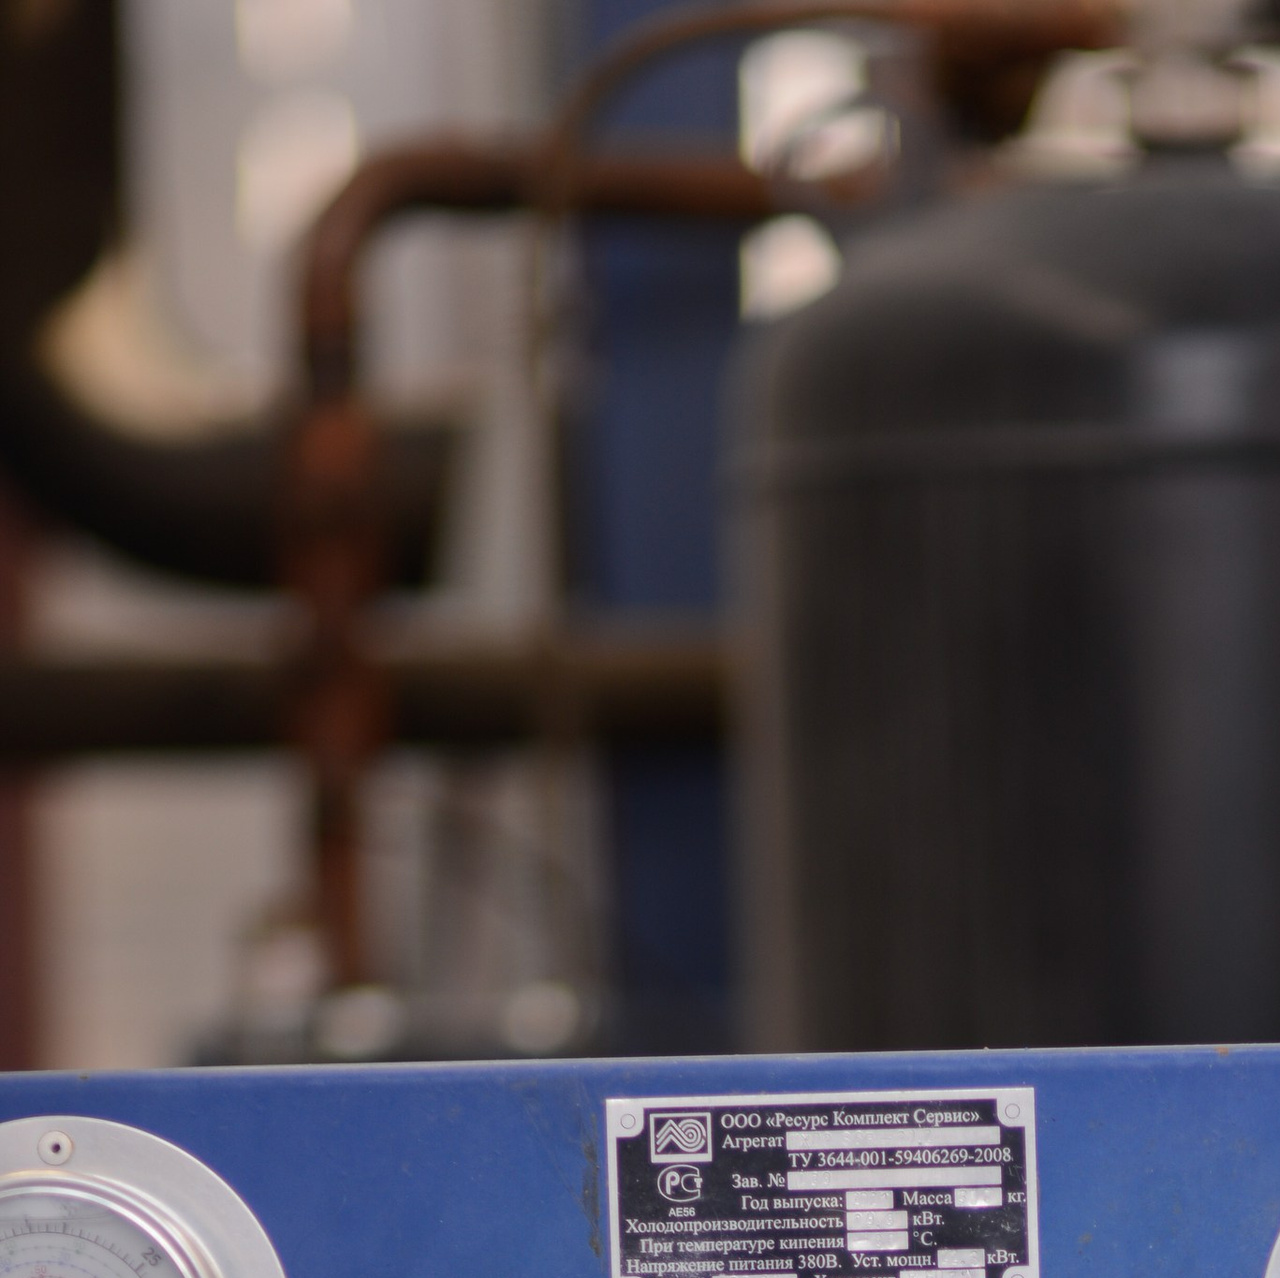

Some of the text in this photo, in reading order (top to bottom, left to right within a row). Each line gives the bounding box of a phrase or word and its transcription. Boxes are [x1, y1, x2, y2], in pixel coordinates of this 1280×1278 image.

[721, 1108, 981, 1130] ООО «Ресурс Комплект Сервис»
[721, 1133, 785, 1152] Агрегат
[788, 1147, 1012, 1168] ТУ 3644-001-59406269-2008
[731, 1173, 763, 1189] Зав.
[767, 1172, 786, 1188] №
[741, 1195, 769, 1211] Год
[773, 1193, 844, 1211] выпуска:
[902, 1191, 953, 1207] Масса
[1007, 1191, 1027, 1204] кг.
[625, 1217, 845, 1235] Холодопроизводительность
[912, 1211, 945, 1226] кВт.
[640, 1239, 674, 1256] При
[677, 1238, 775, 1256] температуре
[779, 1236, 845, 1251] кипения
[142, 1246, 164, 1268] 25
[626, 1258, 725, 1276] Напряжение
[728, 1257, 794, 1272] питания
[797, 1253, 843, 1271] 380В.
[851, 1254, 882, 1269] Уст.
[886, 1255, 936, 1270] мощн.
[986, 1249, 1020, 1265] кВт.
